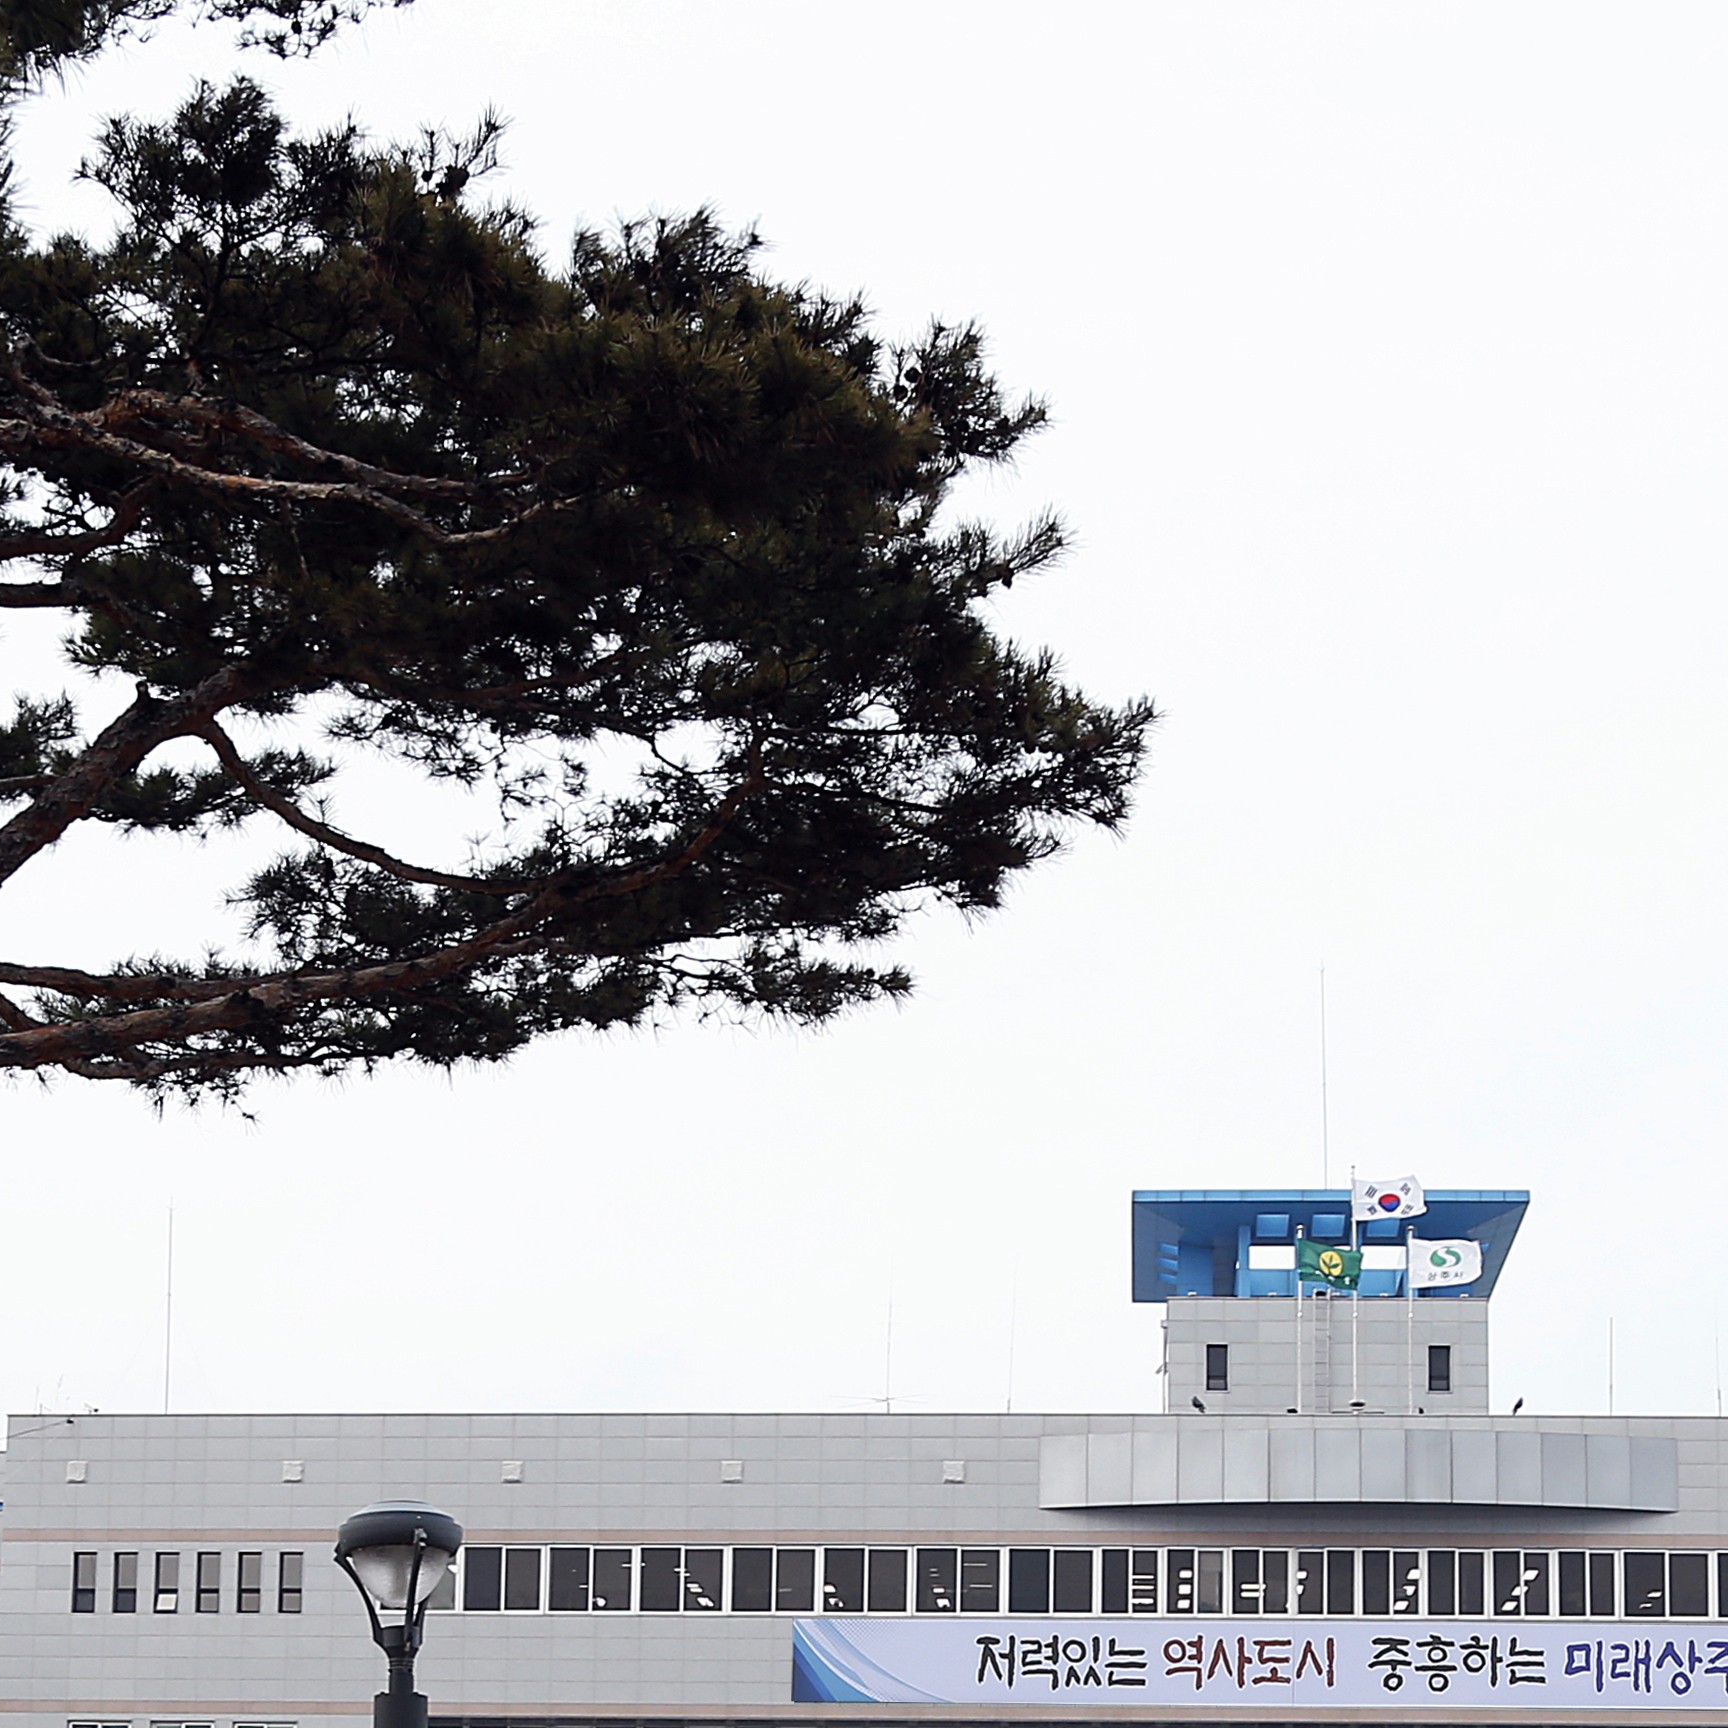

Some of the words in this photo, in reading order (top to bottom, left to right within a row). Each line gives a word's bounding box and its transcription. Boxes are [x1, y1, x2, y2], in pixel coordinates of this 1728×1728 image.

[976, 1634, 1148, 1690] 저력있는
[1163, 1634, 1335, 1690] 역사도시
[1368, 1634, 1547, 1692] 중흥하는
